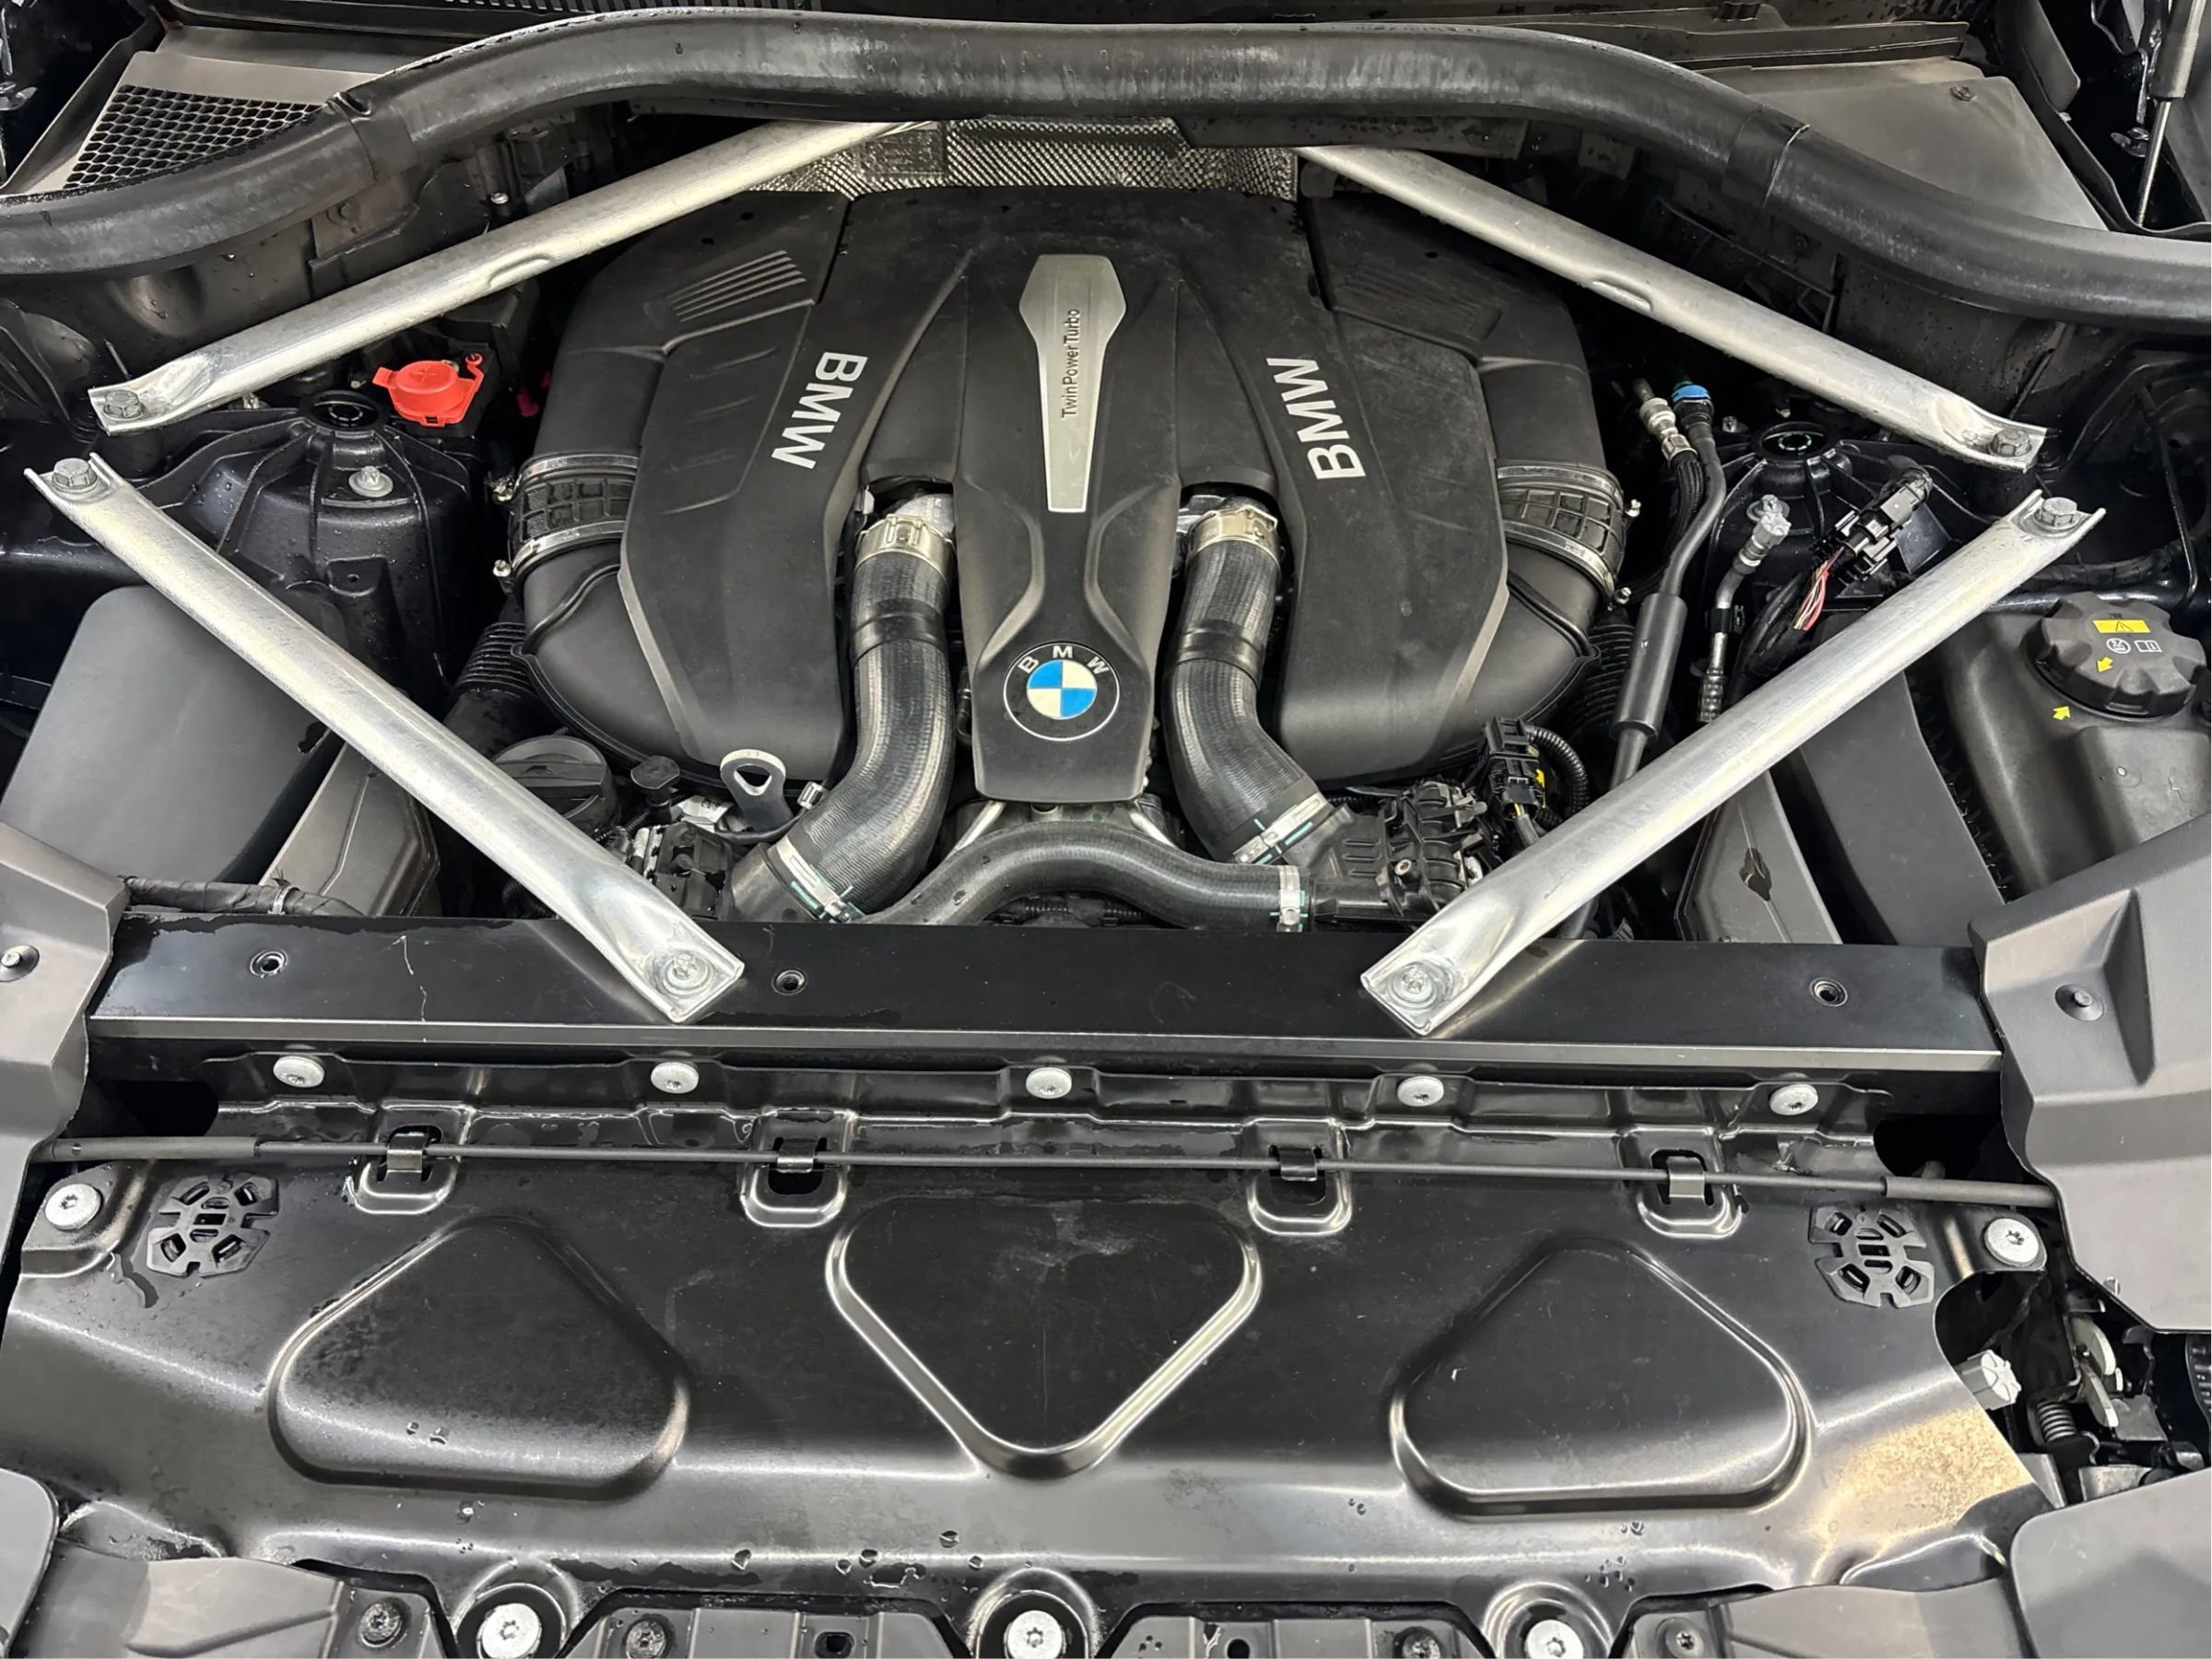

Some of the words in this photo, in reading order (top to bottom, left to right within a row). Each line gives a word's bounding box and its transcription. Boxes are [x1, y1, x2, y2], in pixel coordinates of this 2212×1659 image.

[771, 351, 868, 470] BMW
[1265, 358, 1366, 479] BMW
[1017, 645, 1110, 675] BMW
